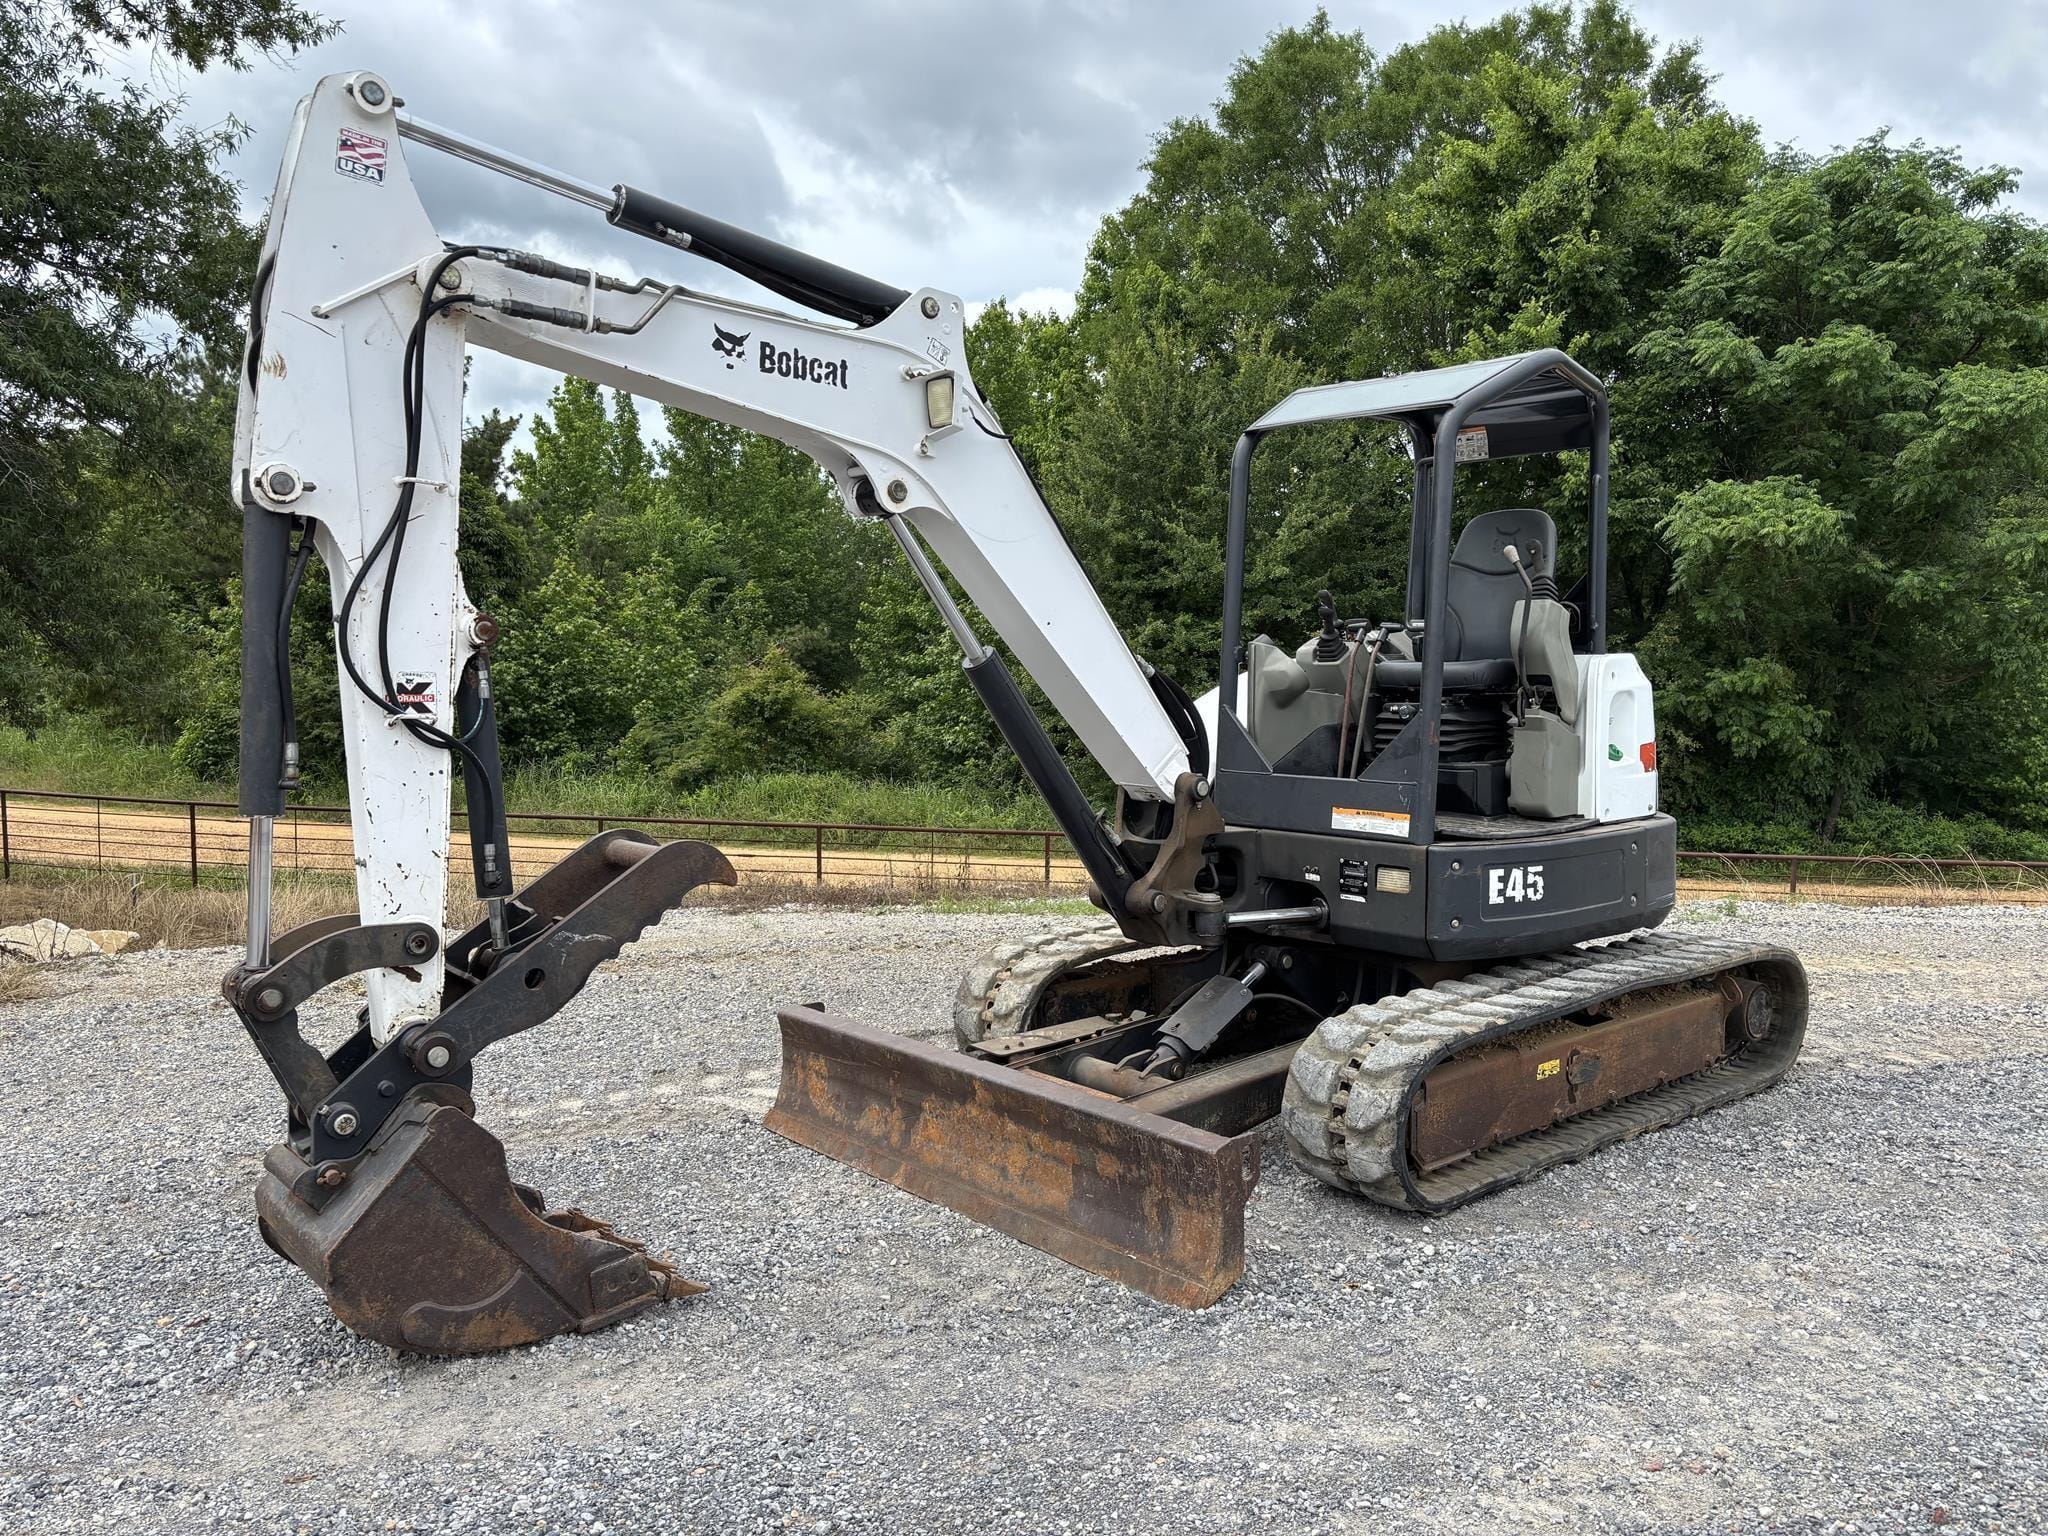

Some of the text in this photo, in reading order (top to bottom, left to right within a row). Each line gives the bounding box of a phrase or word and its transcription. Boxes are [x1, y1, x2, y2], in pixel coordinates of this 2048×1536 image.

[340, 158, 380, 180] USA
[760, 341, 848, 390] Bobcat
[386, 694, 433, 702] DRAULIC
[1489, 865, 1544, 904] E45
